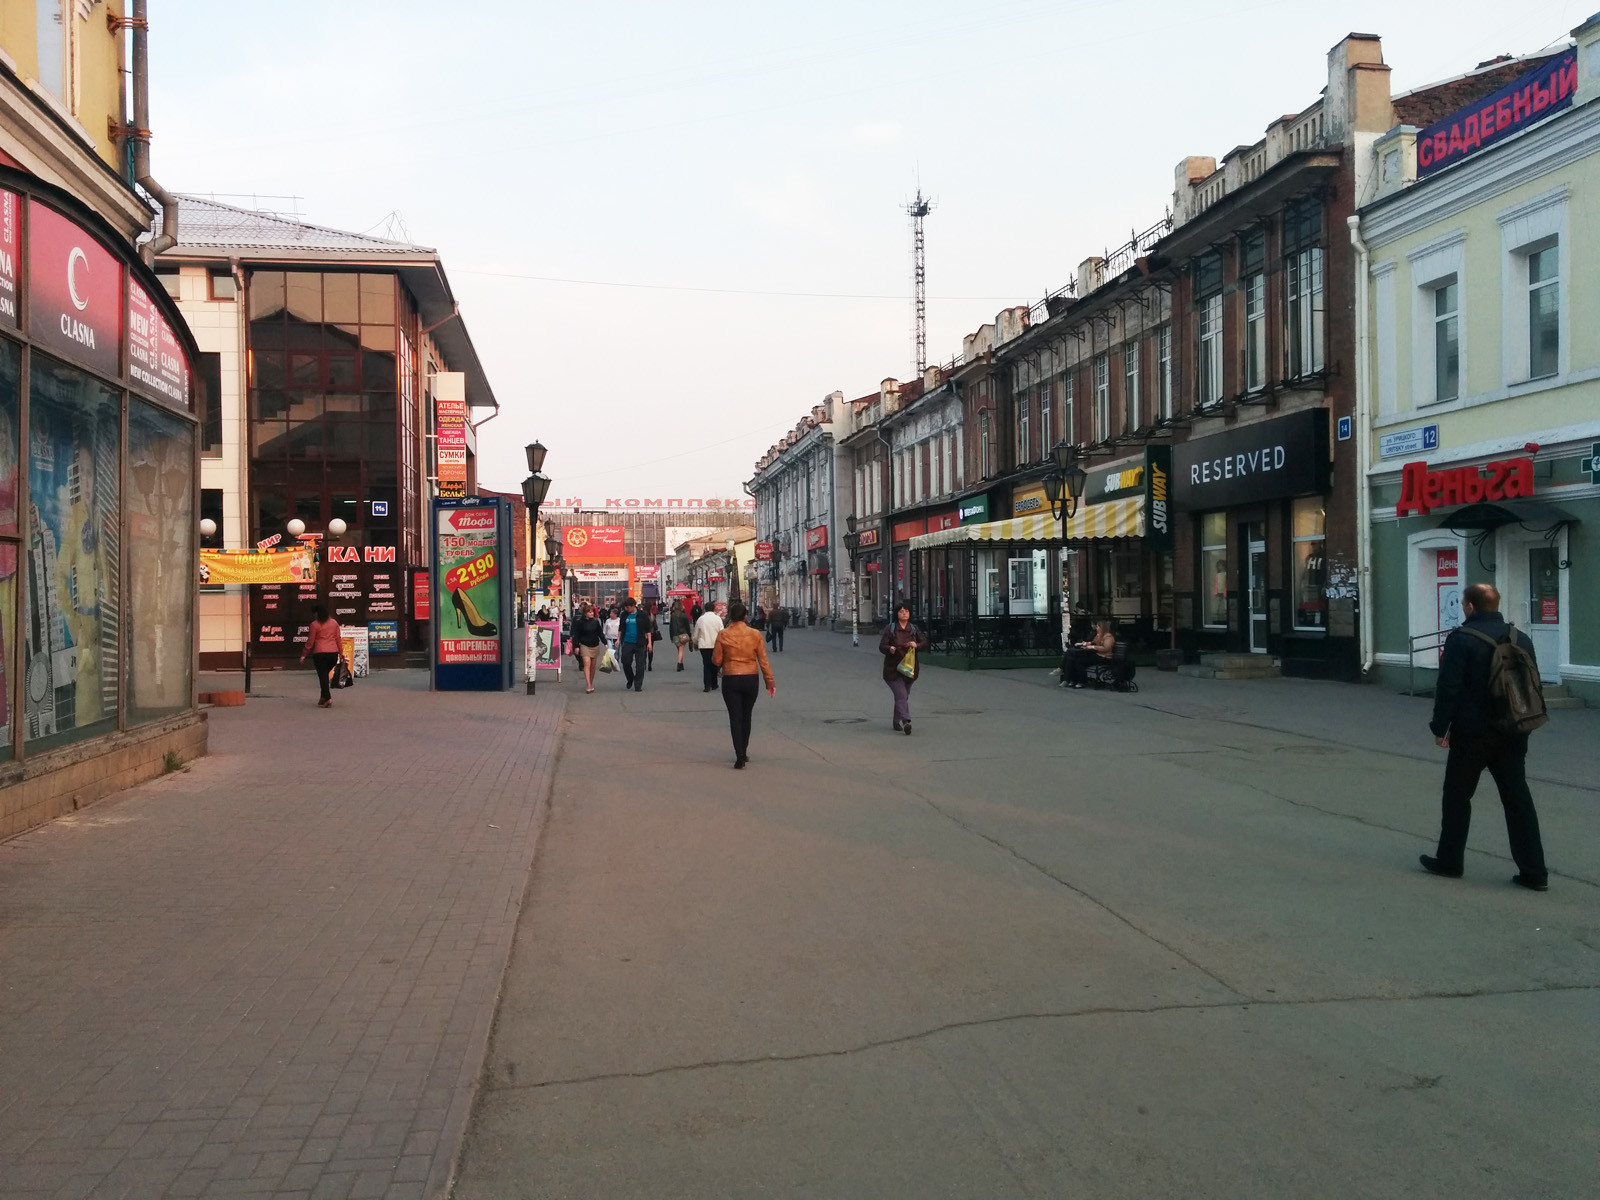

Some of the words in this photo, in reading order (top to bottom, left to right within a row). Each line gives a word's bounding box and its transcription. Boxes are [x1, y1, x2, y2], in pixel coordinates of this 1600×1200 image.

[1419, 55, 1578, 167] СВАДЕБНЫЙ
[130, 309, 149, 338] NEW
[60, 313, 95, 350] CLASNA
[130, 343, 149, 364] CLASNA
[160, 352, 180, 376] CLASNA
[130, 363, 142, 380] NEW
[141, 370, 168, 394] COLLECTION
[168, 384, 183, 402] CLASNA
[438, 402, 464, 410] АТЕЛЬЕ
[1341, 424, 1348, 433] 14
[439, 437, 465, 445] ТАНЦЕВ
[1424, 430, 1436, 444] 12
[439, 451, 465, 459] СУМКИ
[1385, 444, 1404, 454] URITSKY
[1191, 445, 1286, 485] RESERVED
[1104, 465, 1144, 494] SUBWAY
[440, 489, 466, 498] Бельё
[1396, 458, 1535, 518] Деньга
[462, 497, 480, 506] Gallery
[1152, 461, 1168, 535] SUBWAY
[257, 533, 282, 550] МИР
[443, 537, 466, 547] 150
[234, 554, 274, 566] ПАНДА
[328, 546, 361, 563] КА
[364, 546, 396, 563] НИ
[445, 549, 475, 557] ТУФЕЛЬ
[456, 553, 495, 584] 2190
[469, 572, 490, 587] рублей
[443, 641, 455, 652] ТЦ
[445, 652, 482, 663] ЦОКОЛЬНЫЙ
[482, 653, 497, 662] ЭТАЖ
